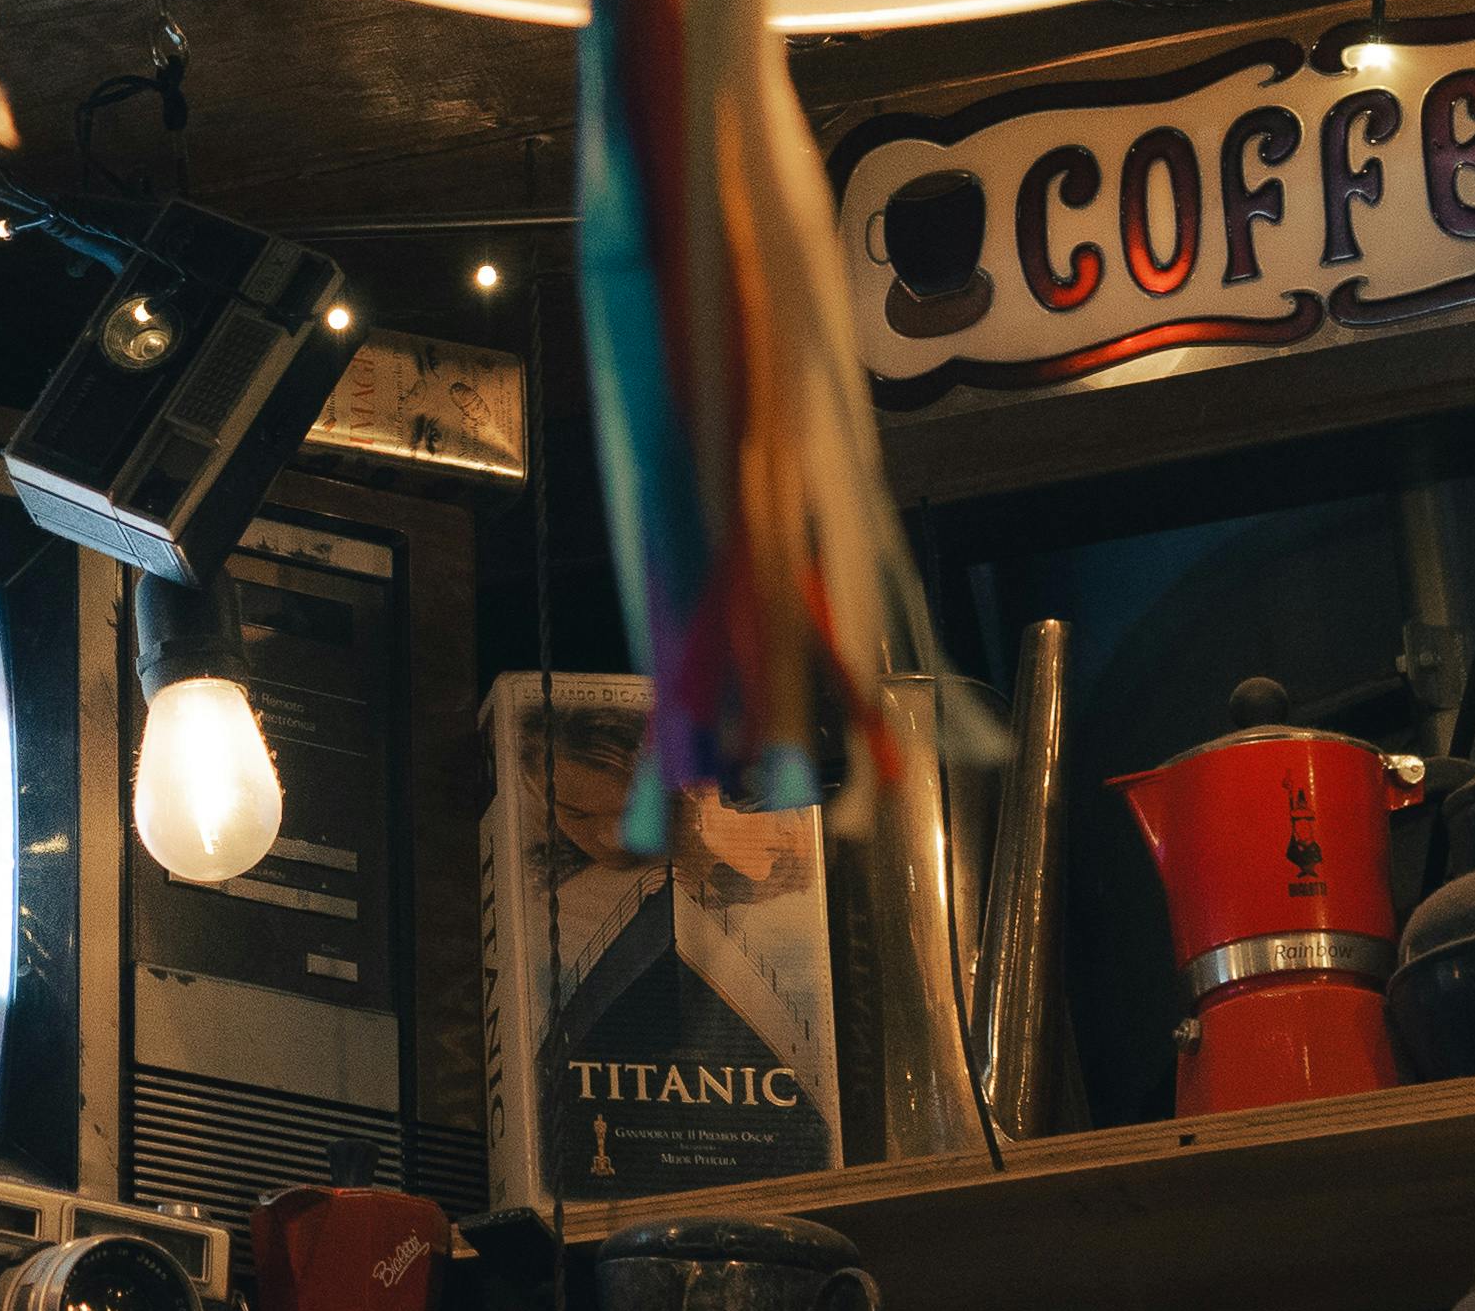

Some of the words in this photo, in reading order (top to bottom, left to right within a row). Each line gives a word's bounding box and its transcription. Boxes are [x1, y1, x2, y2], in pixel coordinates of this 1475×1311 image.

[261, 691, 305, 714] Remoto
[259, 709, 317, 733] lectrónica
[1274, 940, 1353, 961] Rainbow
[481, 836, 505, 1149] TITANIC
[568, 1059, 798, 1108] TITANIC
